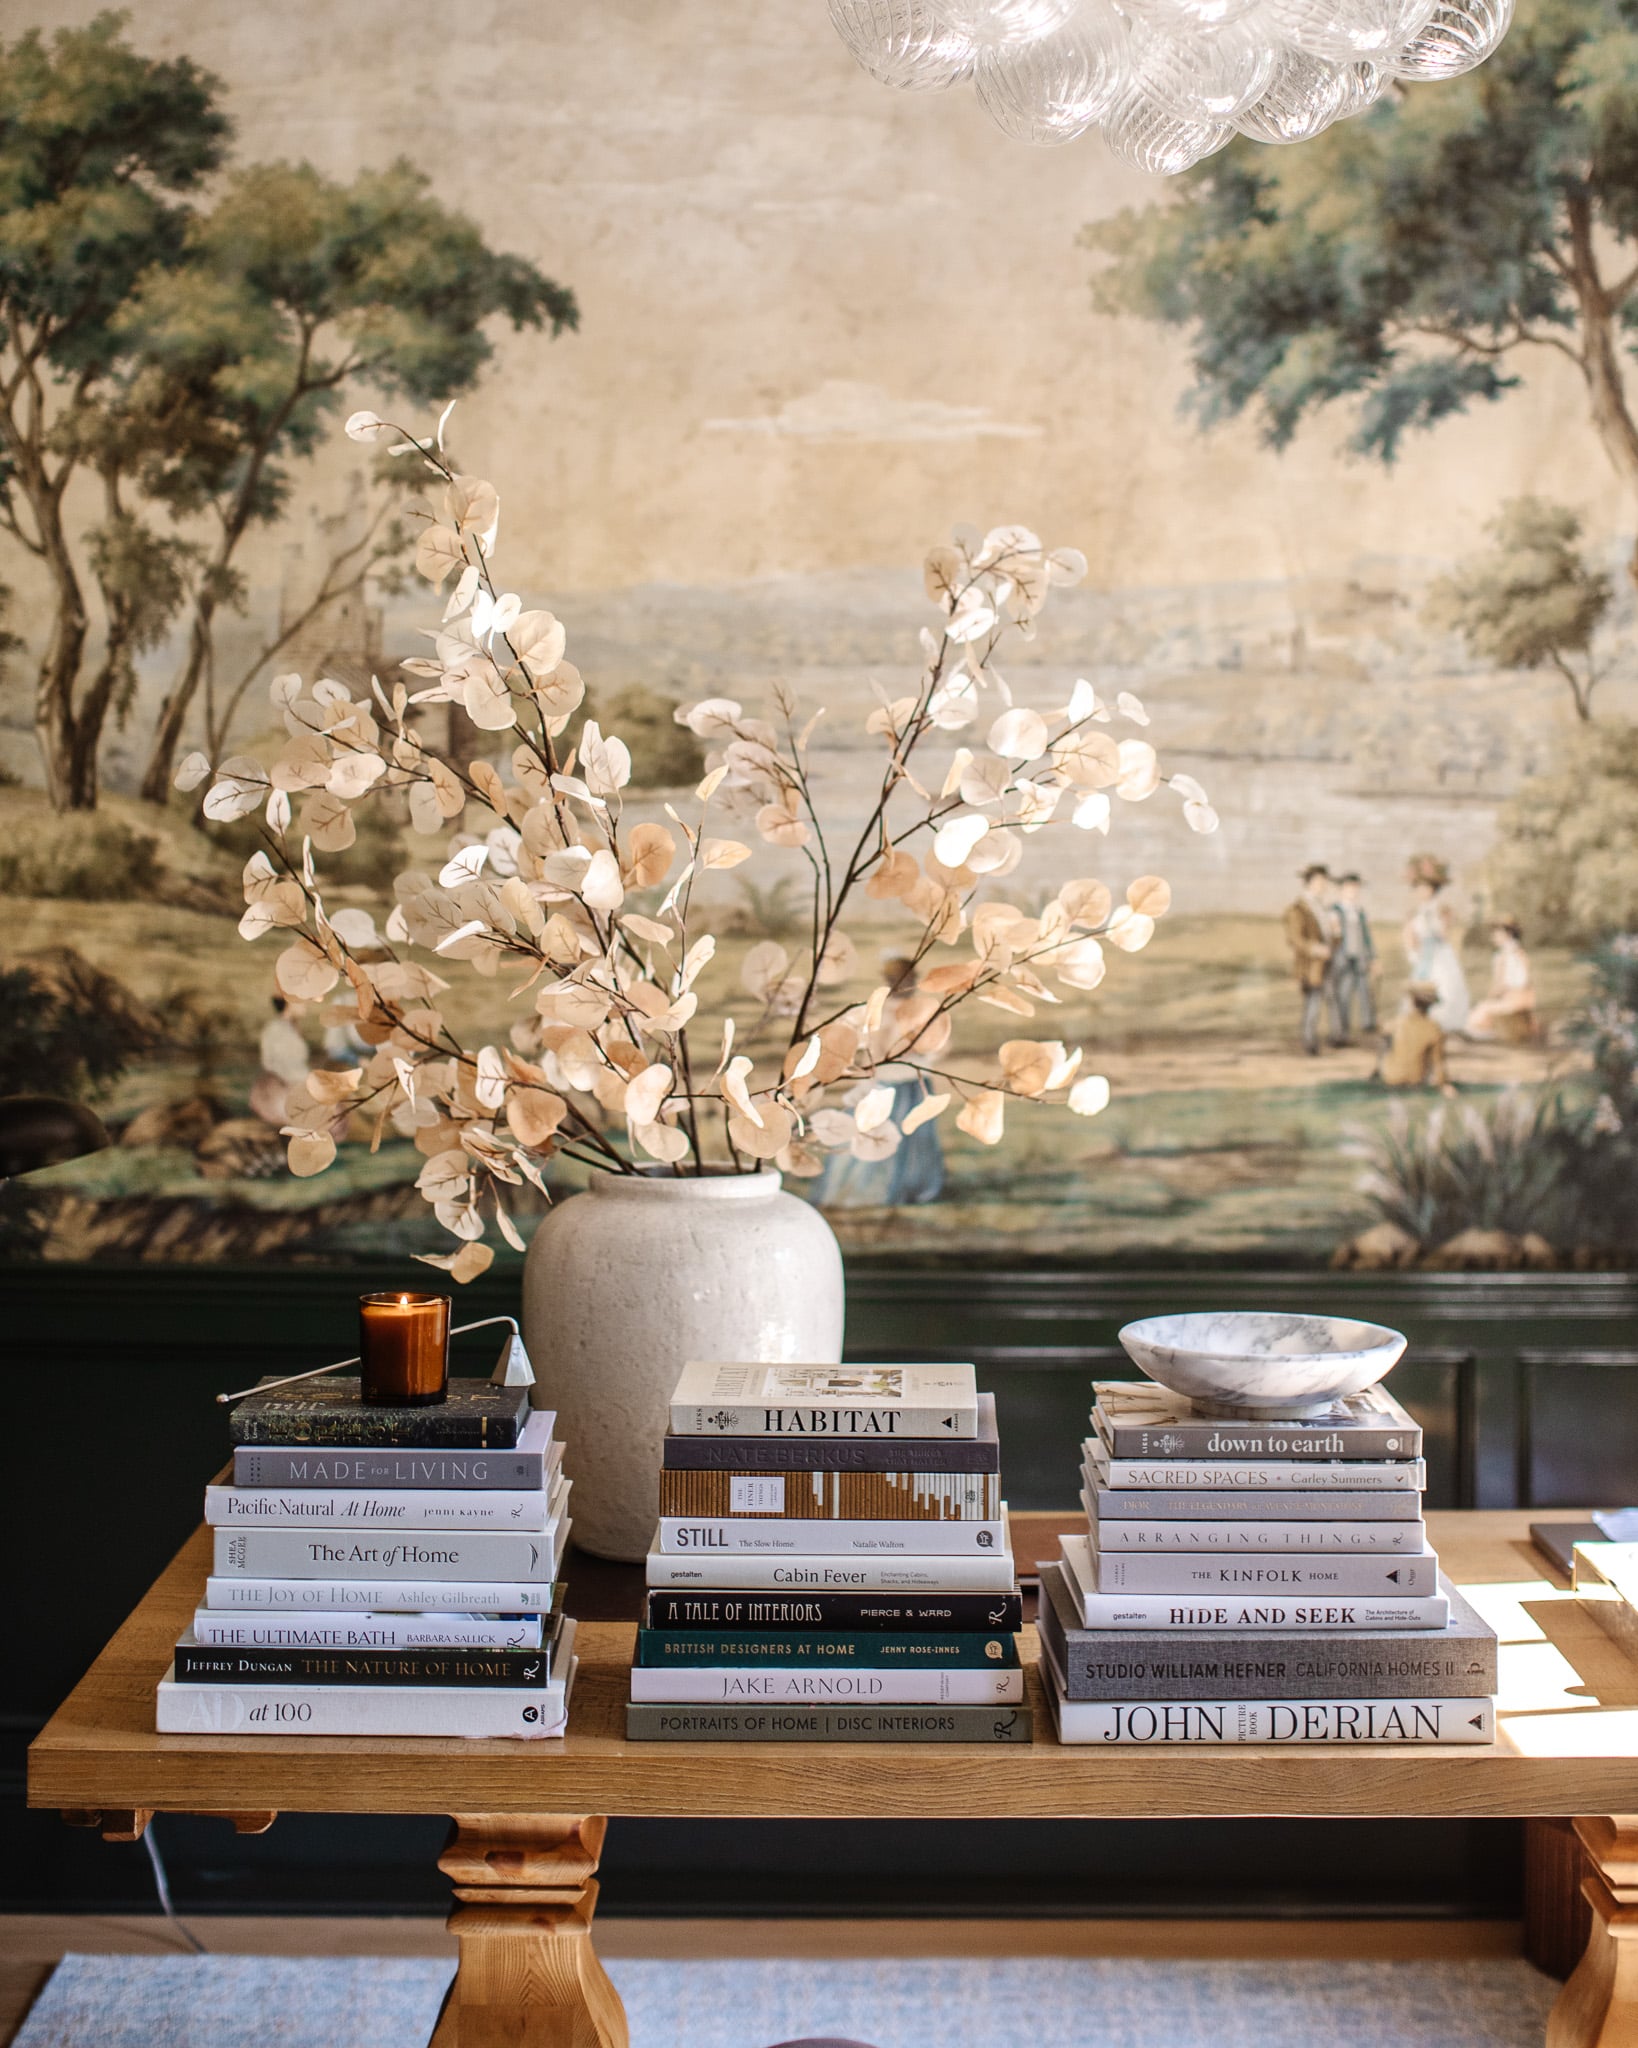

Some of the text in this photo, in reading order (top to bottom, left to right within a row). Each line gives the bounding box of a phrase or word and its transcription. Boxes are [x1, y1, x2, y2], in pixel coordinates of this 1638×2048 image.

[764, 1410, 901, 1432] HABITAT
[1208, 1433, 1344, 1452] down to earth
[708, 1447, 865, 1465] NATE BERKUS
[291, 1462, 365, 1479] MADE
[396, 1462, 487, 1479] LIVING
[1129, 1471, 1382, 1486] SACRED SPACES Carley Summers
[747, 1482, 755, 1507] FINER
[228, 1498, 276, 1514] Pacific
[280, 1499, 333, 1515] Natural
[341, 1502, 359, 1516] At
[363, 1501, 405, 1517] Home
[677, 1528, 728, 1546] STILL
[1121, 1533, 1375, 1544] ARRANGING THINGS
[238, 1537, 246, 1568] MCGEE
[309, 1545, 458, 1566] The Art of Home
[774, 1568, 818, 1582] Cabin
[825, 1570, 866, 1583] Fever
[1221, 1570, 1301, 1582] KINFOLK
[229, 1587, 499, 1607] THE JOY OF HOME Ashley Gilbreath
[669, 1603, 677, 1619] A
[685, 1603, 719, 1620] TALE
[726, 1603, 742, 1620] OF
[749, 1604, 821, 1621] INTERIORS
[1170, 1609, 1227, 1624] HIDE
[1237, 1609, 1285, 1623] AND
[1296, 1608, 1355, 1623] SEEK
[209, 1630, 245, 1645] THE
[252, 1630, 342, 1646] ULTIMATE
[348, 1631, 394, 1645] BATH
[455, 1635, 495, 1643] SALLICK
[665, 1644, 714, 1653] BRITISH
[721, 1644, 791, 1654] DESIGNERS
[798, 1645, 811, 1654] AT
[818, 1645, 854, 1654] HOME
[187, 1659, 510, 1676] JEFFREY DUNGAN THE NATURE OF HOME
[1086, 1664, 1145, 1679] STUDIO
[1151, 1664, 1218, 1678] WILLIAM
[1224, 1662, 1285, 1678] HEFNER
[1296, 1662, 1383, 1677] CALIFORNIA
[1388, 1662, 1439, 1676] HOMES
[723, 1678, 882, 1697] JAKE ARNOLD
[250, 1705, 269, 1721] at
[276, 1704, 311, 1720] 100
[661, 1717, 738, 1730] PORTRAITS
[745, 1717, 765, 1729] OF
[772, 1718, 817, 1729] HOME
[838, 1717, 872, 1730] DISC
[879, 1717, 954, 1729] INTERIORS
[1104, 1707, 1226, 1741] JOHN
[1266, 1706, 1442, 1740] DERIAN
[1236, 1705, 1248, 1742] PICTURE
